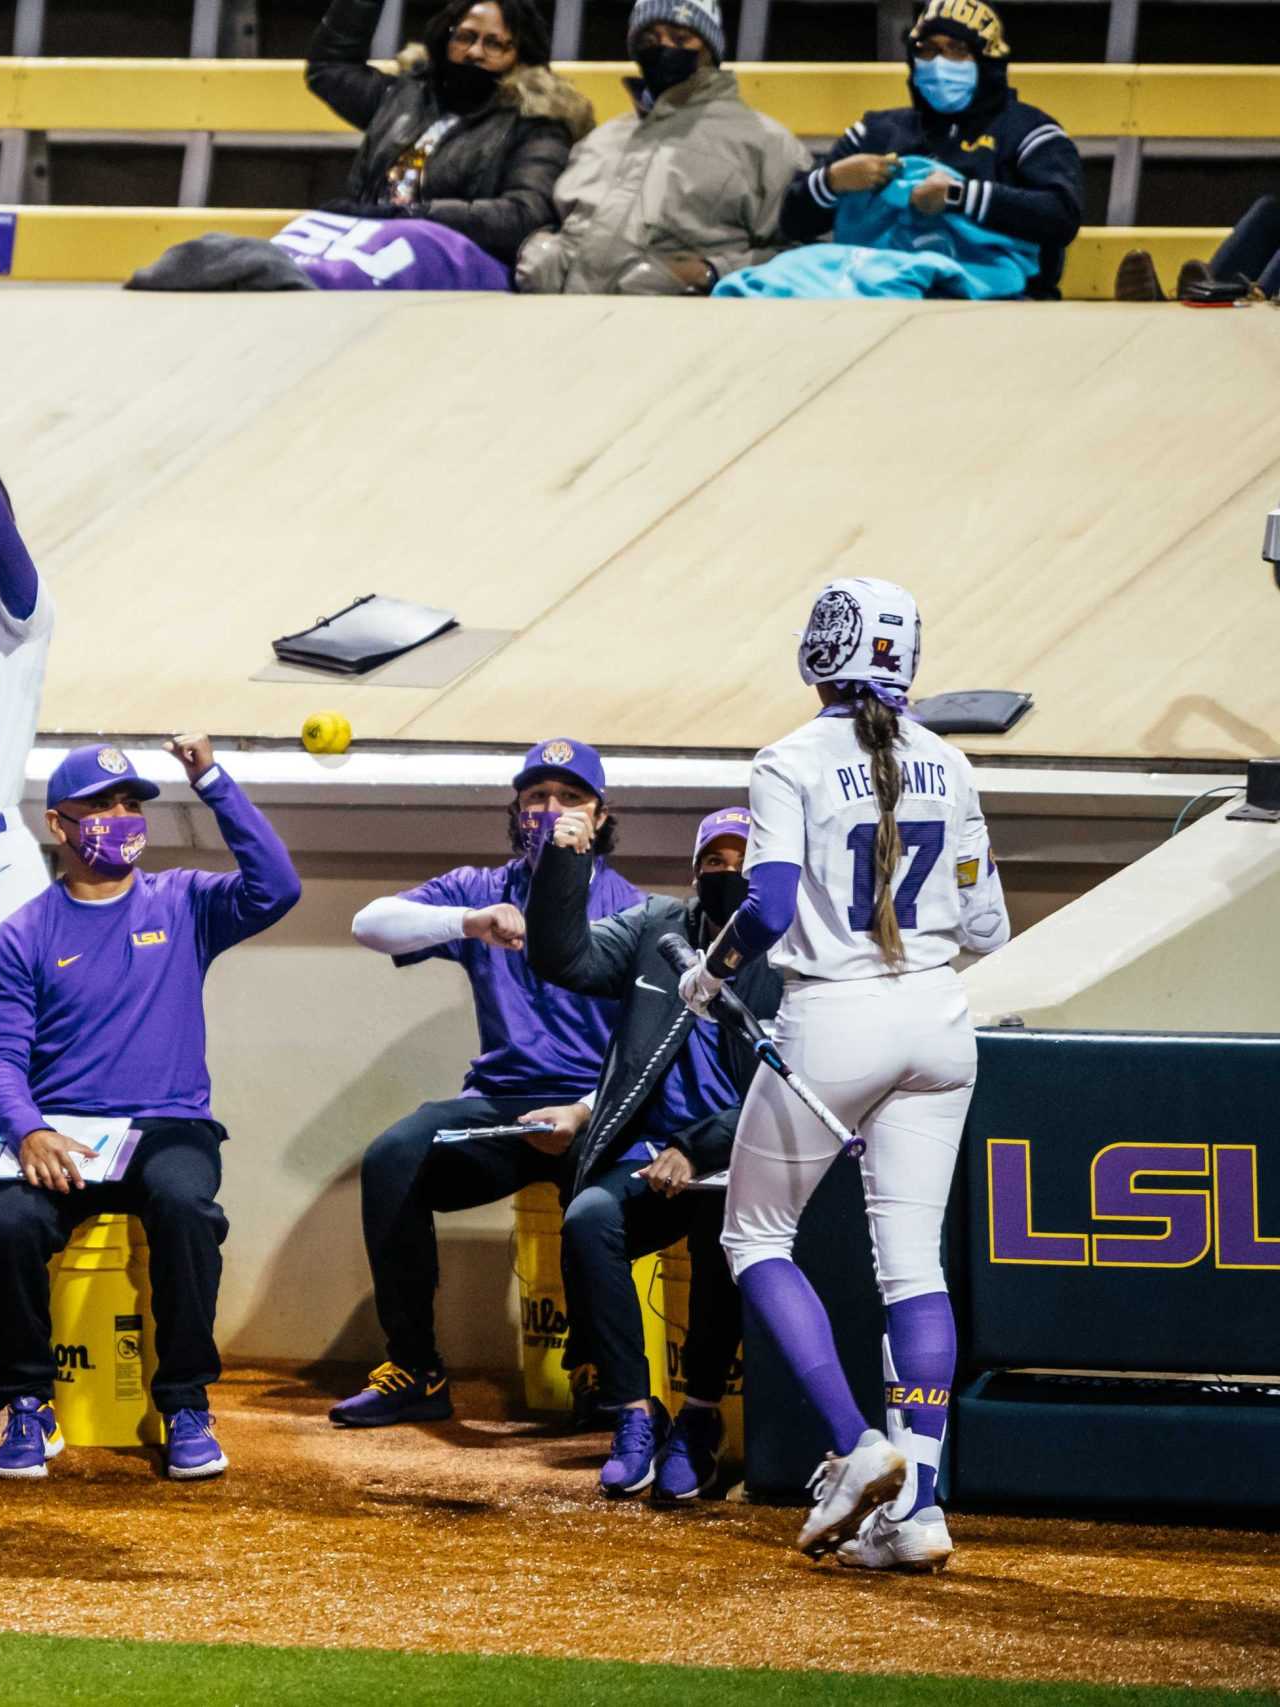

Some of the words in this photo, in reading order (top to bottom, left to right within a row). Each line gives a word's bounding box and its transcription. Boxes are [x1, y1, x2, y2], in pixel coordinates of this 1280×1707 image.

[837, 761, 946, 800] PLEANTS
[85, 825, 110, 836] LSU
[847, 820, 946, 932] 17
[132, 930, 167, 946] LSU
